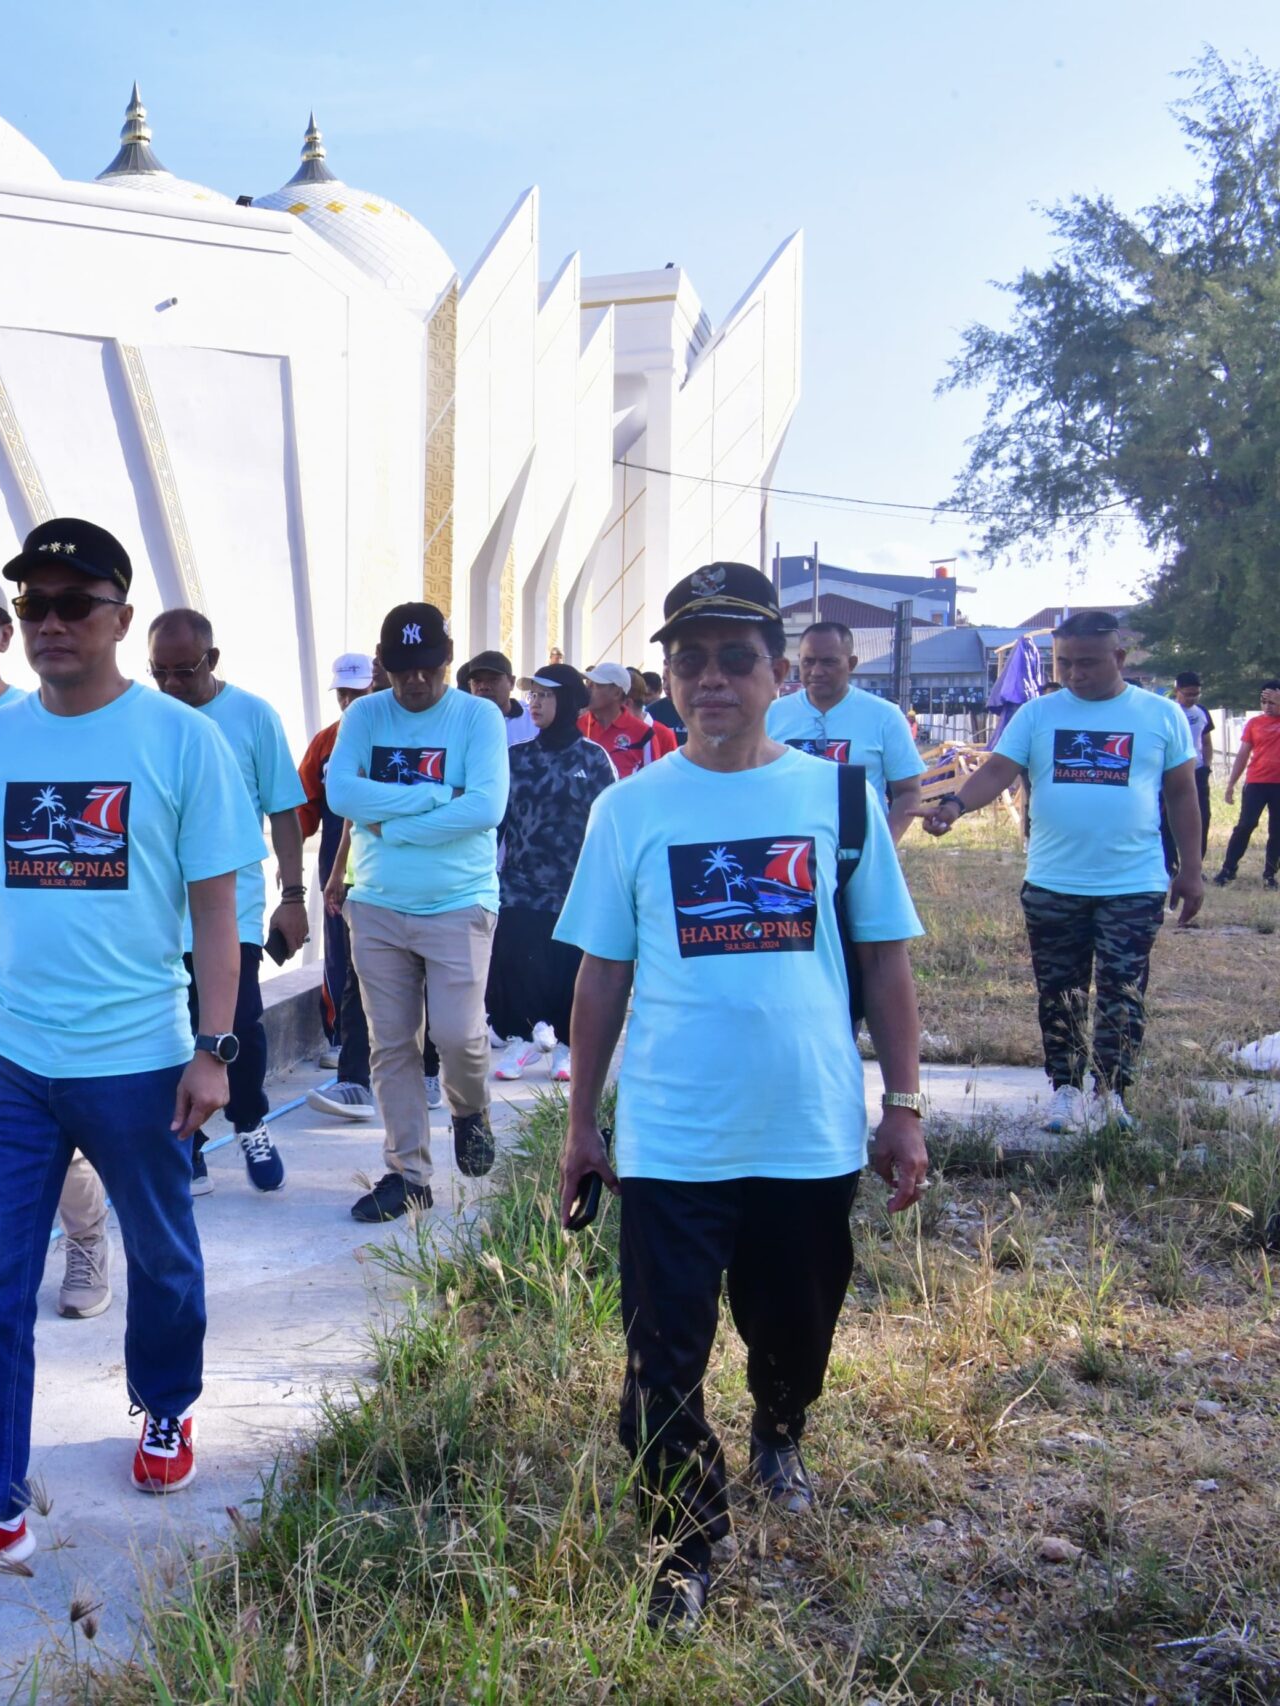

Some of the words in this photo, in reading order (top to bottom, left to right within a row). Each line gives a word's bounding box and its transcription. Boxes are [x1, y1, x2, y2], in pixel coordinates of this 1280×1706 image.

[1054, 768, 1128, 781] HARKOPNAS
[7, 860, 126, 878] HARKOPNAS
[680, 921, 812, 944] HARKOPNAS
[724, 942, 758, 951] SULSEL
[760, 940, 781, 949] 2024
